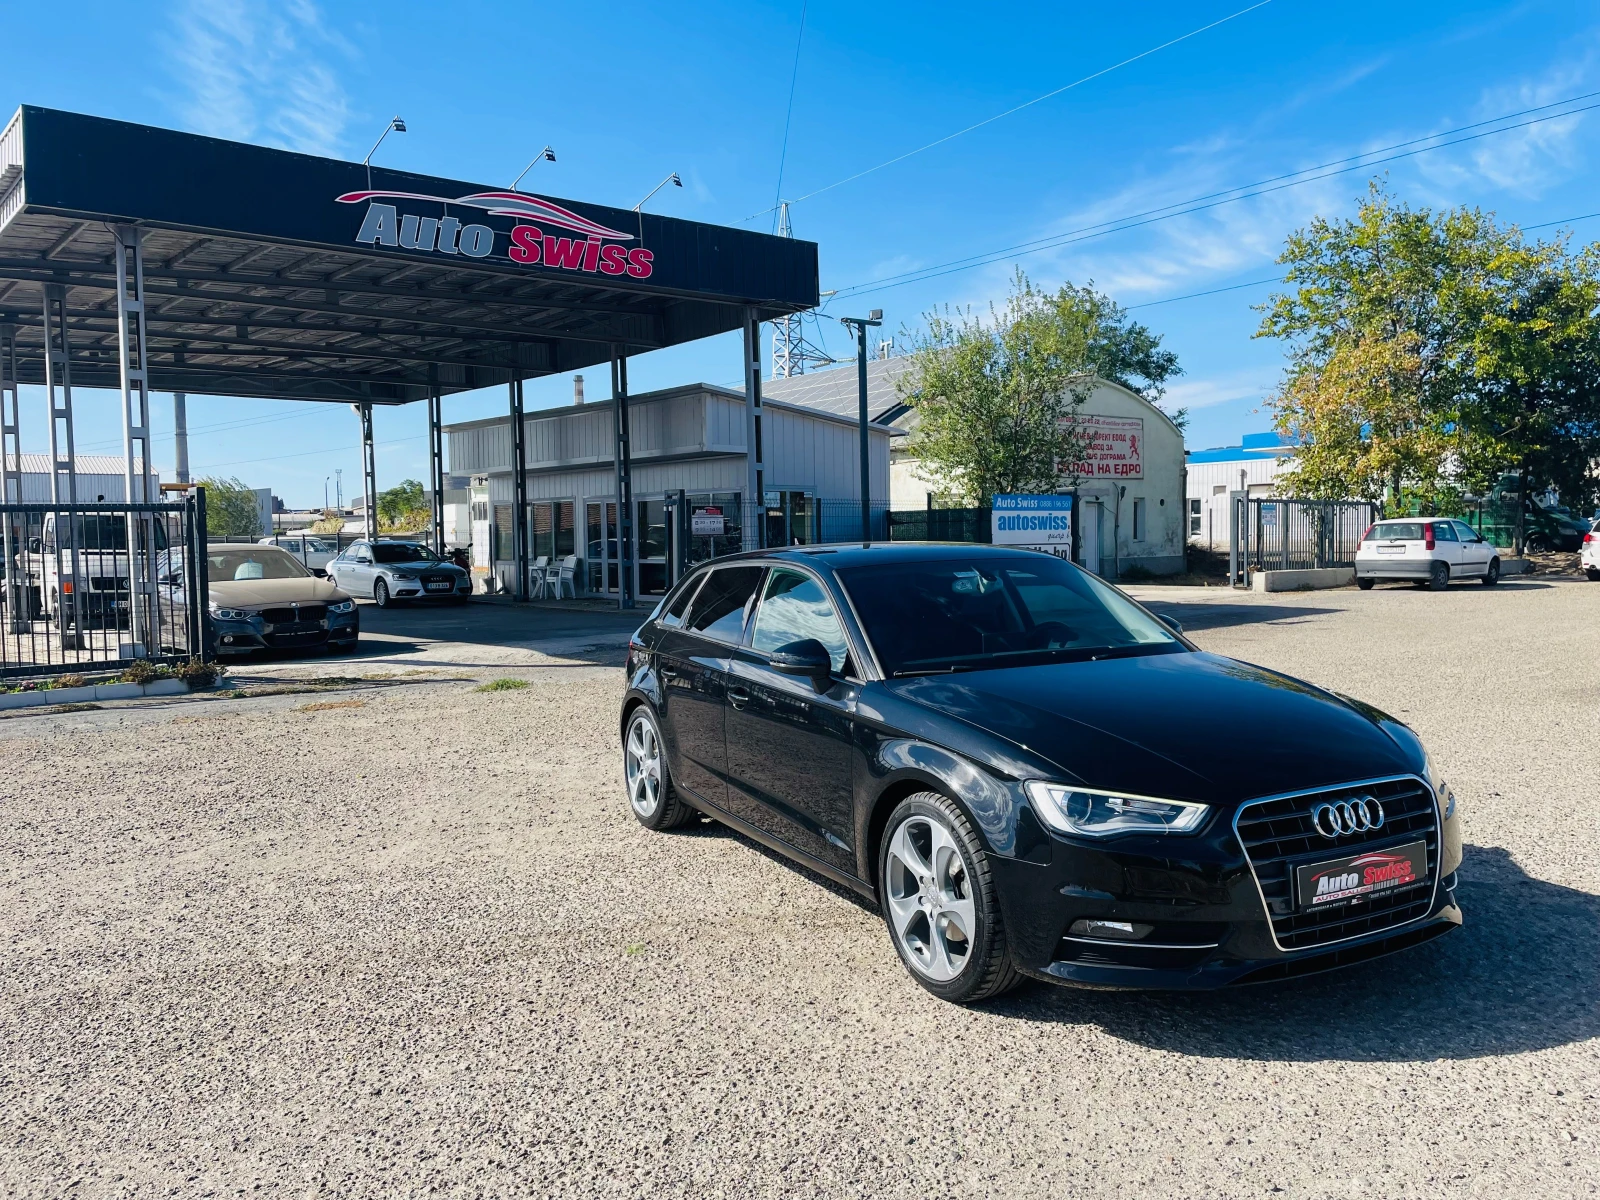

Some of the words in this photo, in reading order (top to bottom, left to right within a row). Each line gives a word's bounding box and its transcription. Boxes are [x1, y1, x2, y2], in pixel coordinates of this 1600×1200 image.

[355, 202, 495, 258] Auto
[508, 224, 655, 279] Swiss
[1097, 464, 1111, 474] НА
[1114, 464, 1141, 476] ЕДРО
[996, 498, 1016, 508] Auto
[1017, 497, 1038, 508] Swiss
[1316, 872, 1359, 896] Auto
[1363, 860, 1411, 885] Swiss
[1315, 892, 1340, 903] AUTO
